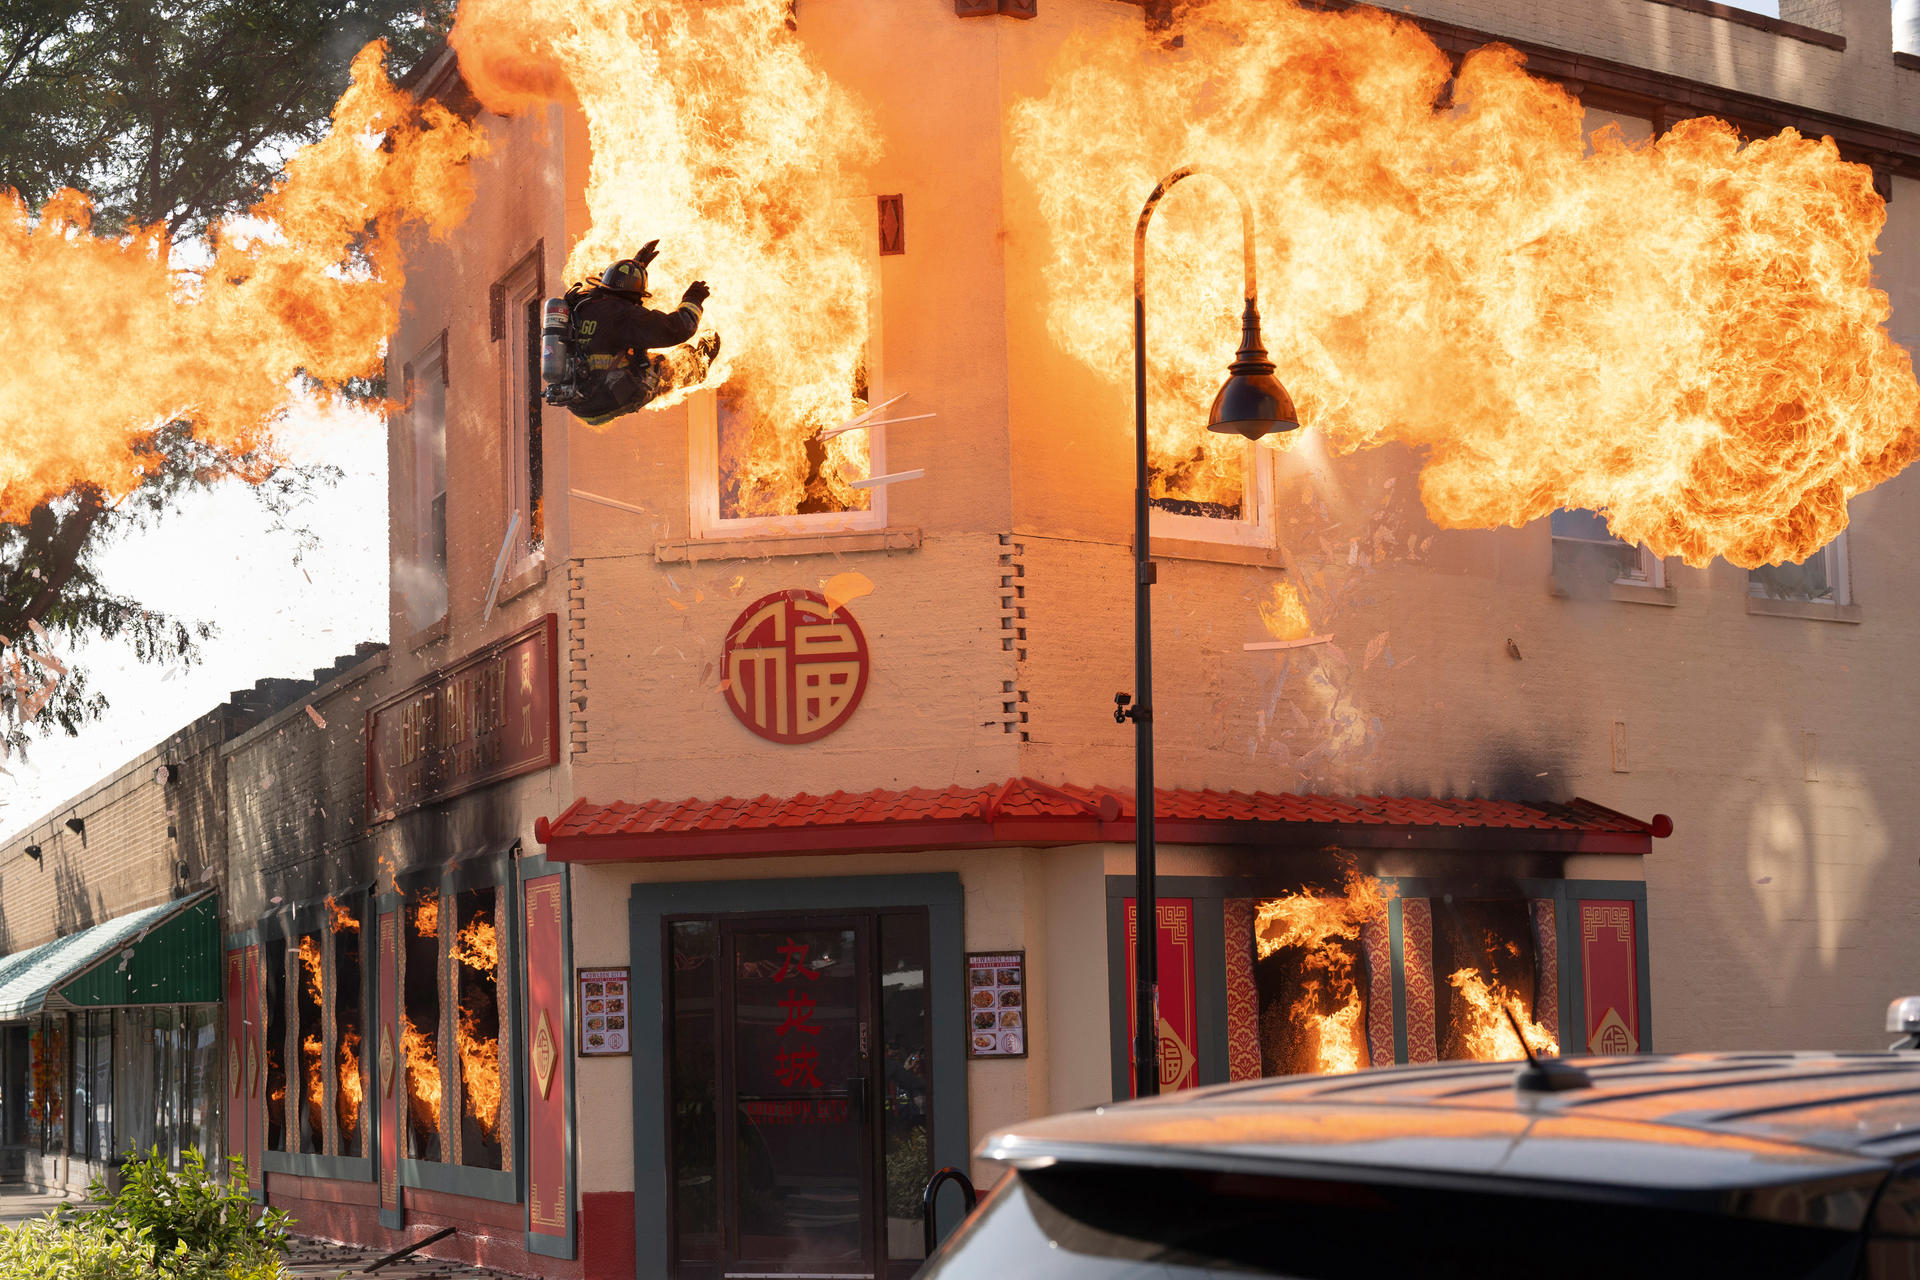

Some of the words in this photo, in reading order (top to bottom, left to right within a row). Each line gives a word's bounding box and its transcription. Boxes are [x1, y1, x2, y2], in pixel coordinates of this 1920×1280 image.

[579, 319, 597, 336] GO
[727, 598, 862, 736] 福
[773, 936, 823, 1088] 九龙城
[748, 1101, 811, 1114] KOWLOON
[817, 1099, 848, 1113] CITY
